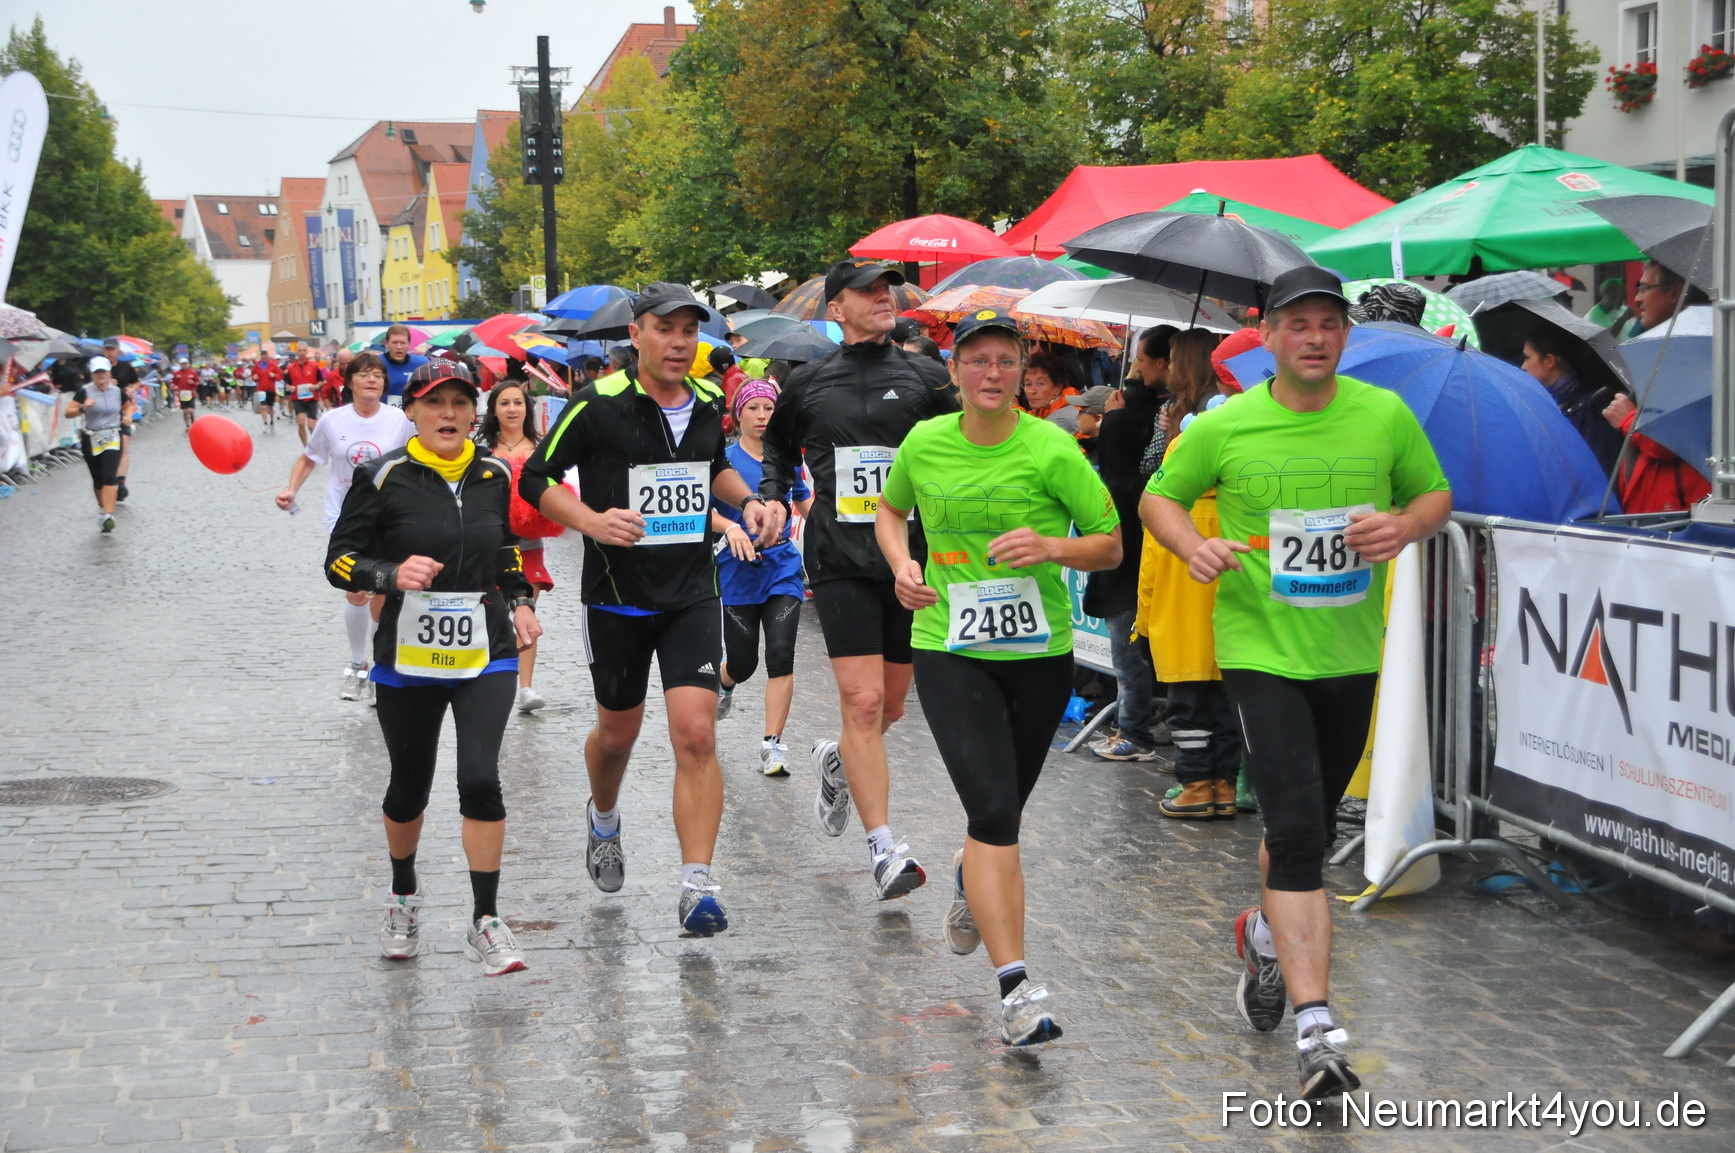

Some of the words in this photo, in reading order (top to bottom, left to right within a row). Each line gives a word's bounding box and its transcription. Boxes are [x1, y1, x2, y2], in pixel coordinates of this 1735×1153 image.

[656, 468, 688, 476] BOCK
[853, 466, 892, 494] 51
[639, 483, 705, 514] 2885
[864, 500, 877, 511] Pe
[652, 520, 695, 533] Gerhard
[1304, 514, 1347, 526] BOCK
[978, 584, 1014, 596] BOCK
[1289, 578, 1357, 594] Sommerer
[959, 601, 1038, 640] 2489
[418, 614, 473, 647] 399
[431, 652, 455, 666] Rita
[1519, 731, 1605, 772] INTERNETLÖSUNGEN
[1618, 760, 1728, 812] SCHULUNGSZENTRUM
